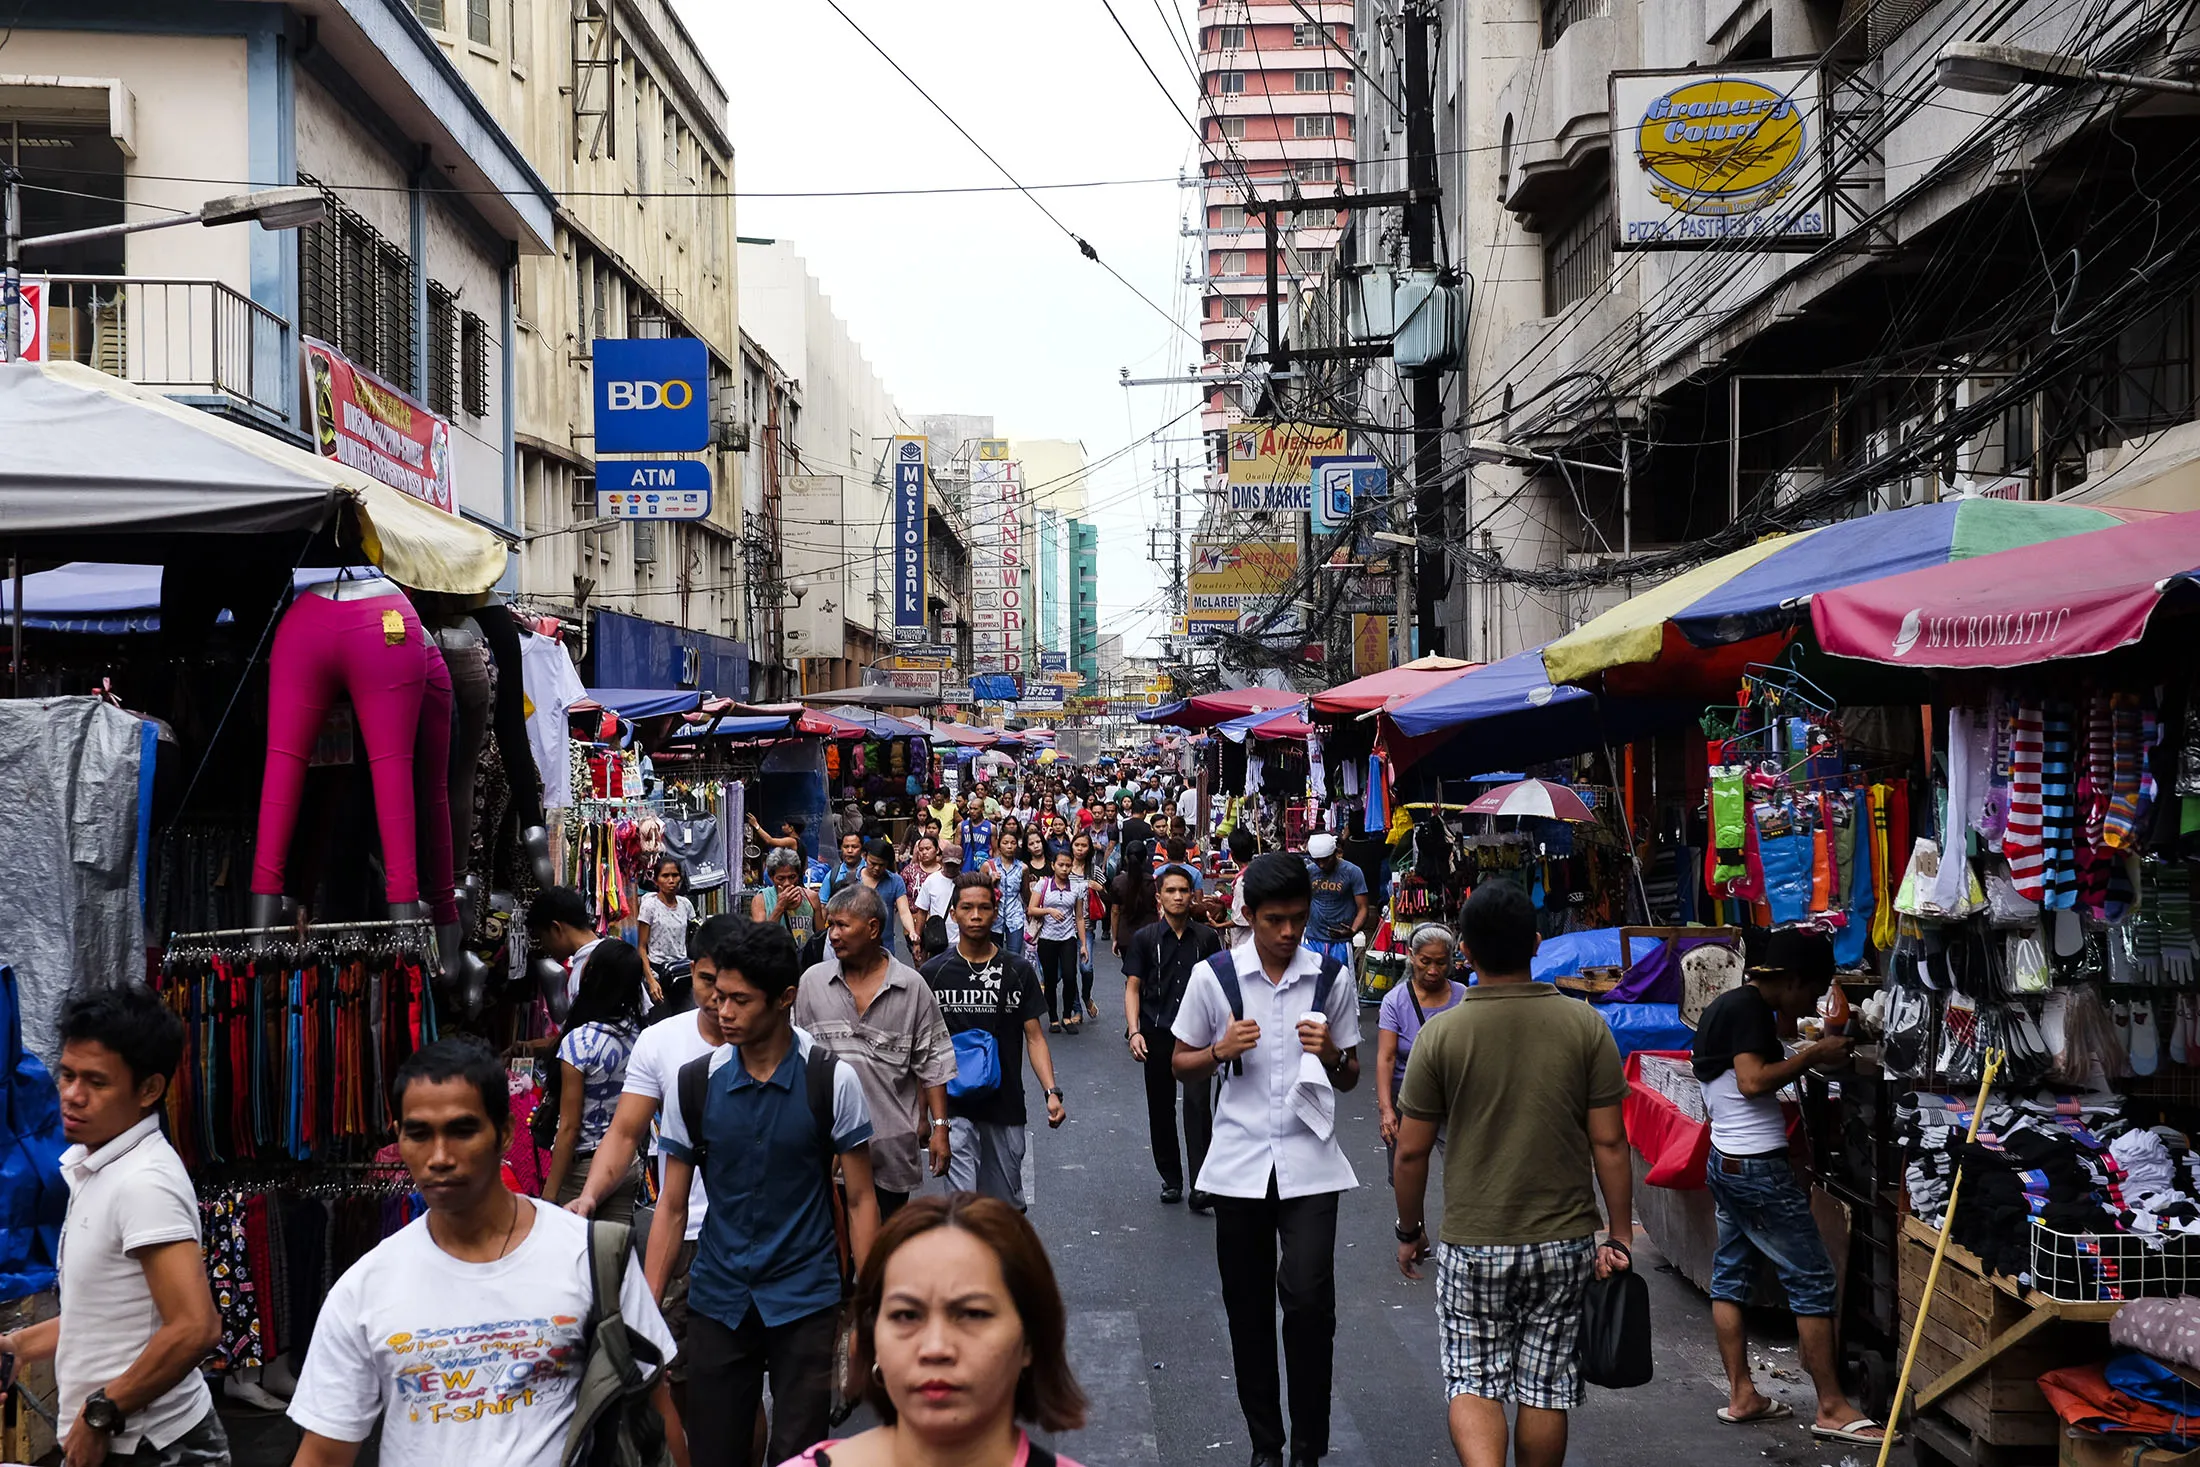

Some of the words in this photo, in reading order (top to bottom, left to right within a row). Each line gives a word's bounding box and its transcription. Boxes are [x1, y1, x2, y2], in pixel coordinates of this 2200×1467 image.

[1647, 95, 1793, 121] Granary
[1664, 120, 1761, 143] Court
[1680, 217, 1747, 238] PASTRIES
[1773, 212, 1822, 233] CAKES
[608, 379, 693, 411] BDO
[1259, 429, 1344, 456] AMERICAN
[630, 468, 676, 487] ATM
[1232, 486, 1260, 509] DMS
[904, 466, 919, 611] Metrobank
[1001, 463, 1020, 672] TRANSWORLD
[1194, 597, 1240, 608] McLAREN
[1925, 607, 2070, 648] MICROMATIC
[682, 646, 700, 687] BDO
[415, 1318, 549, 1339] Someone
[395, 1369, 476, 1394] NEW
[429, 1388, 537, 1424] T-shirt
